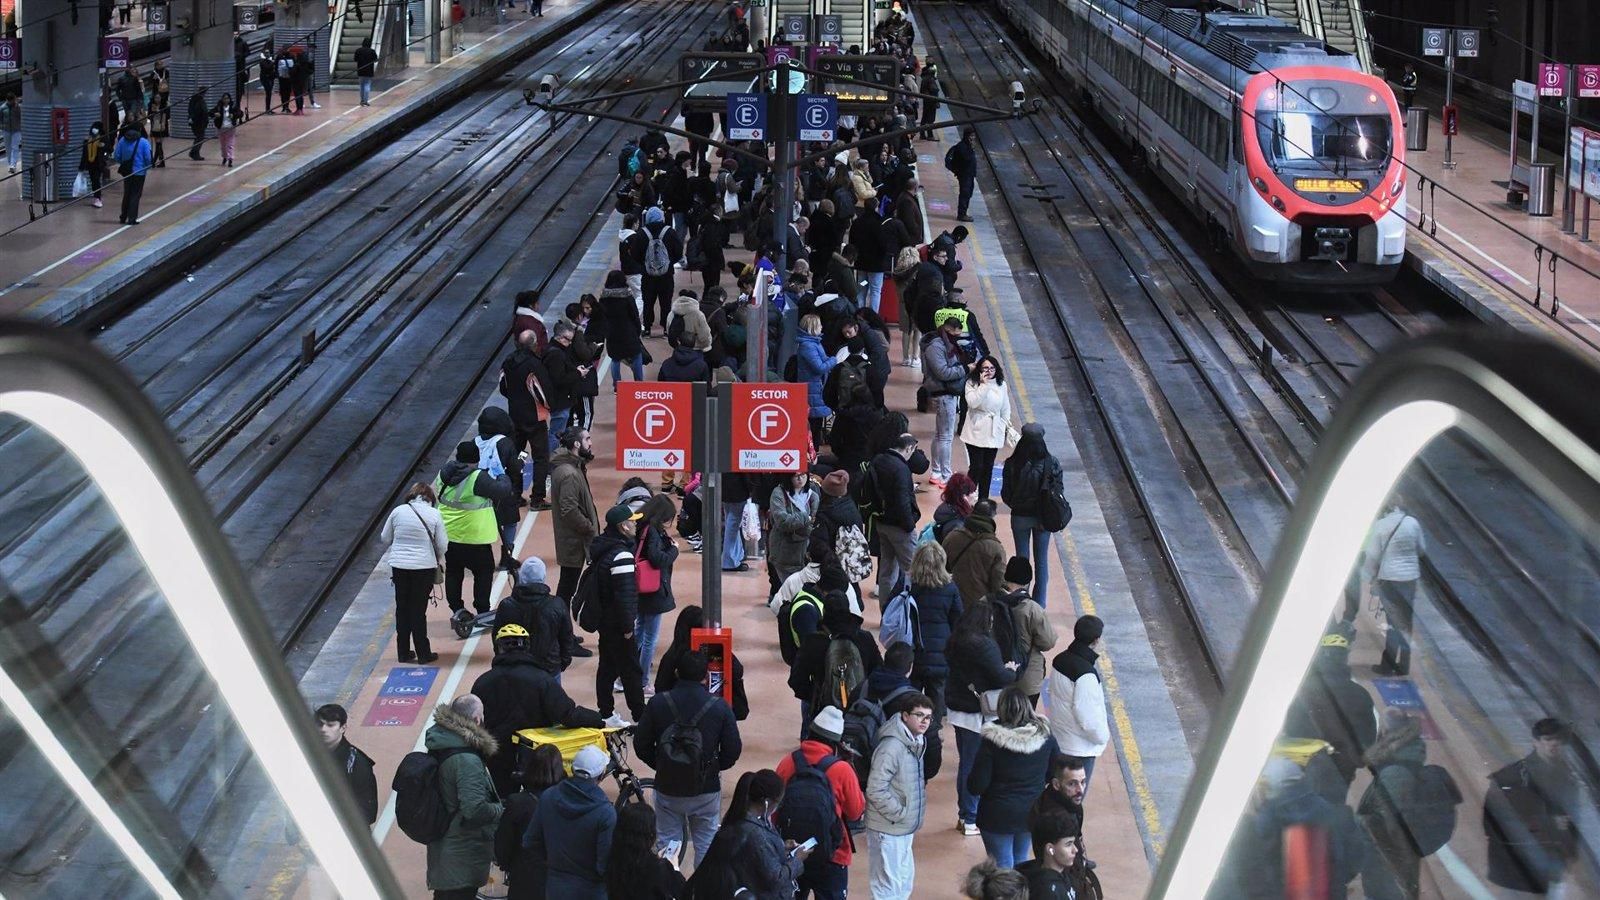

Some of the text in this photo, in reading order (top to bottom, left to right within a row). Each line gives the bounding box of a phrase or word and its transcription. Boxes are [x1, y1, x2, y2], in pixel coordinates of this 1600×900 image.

[791, 22, 800, 31] C
[826, 22, 835, 31] C
[1430, 36, 1439, 45] C
[1464, 37, 1472, 46] C
[720, 60, 728, 69] 4
[857, 63, 864, 72] 3
[1548, 73, 1557, 84] D
[741, 107, 752, 123] E
[811, 108, 823, 124] E
[634, 391, 673, 400] SECTOR
[751, 389, 788, 399] SECTOR
[645, 409, 666, 437] F
[760, 410, 779, 438] F
[629, 459, 660, 468] Platform
[667, 455, 675, 464] 4
[783, 455, 791, 464] 3
[744, 460, 776, 469] Platform
